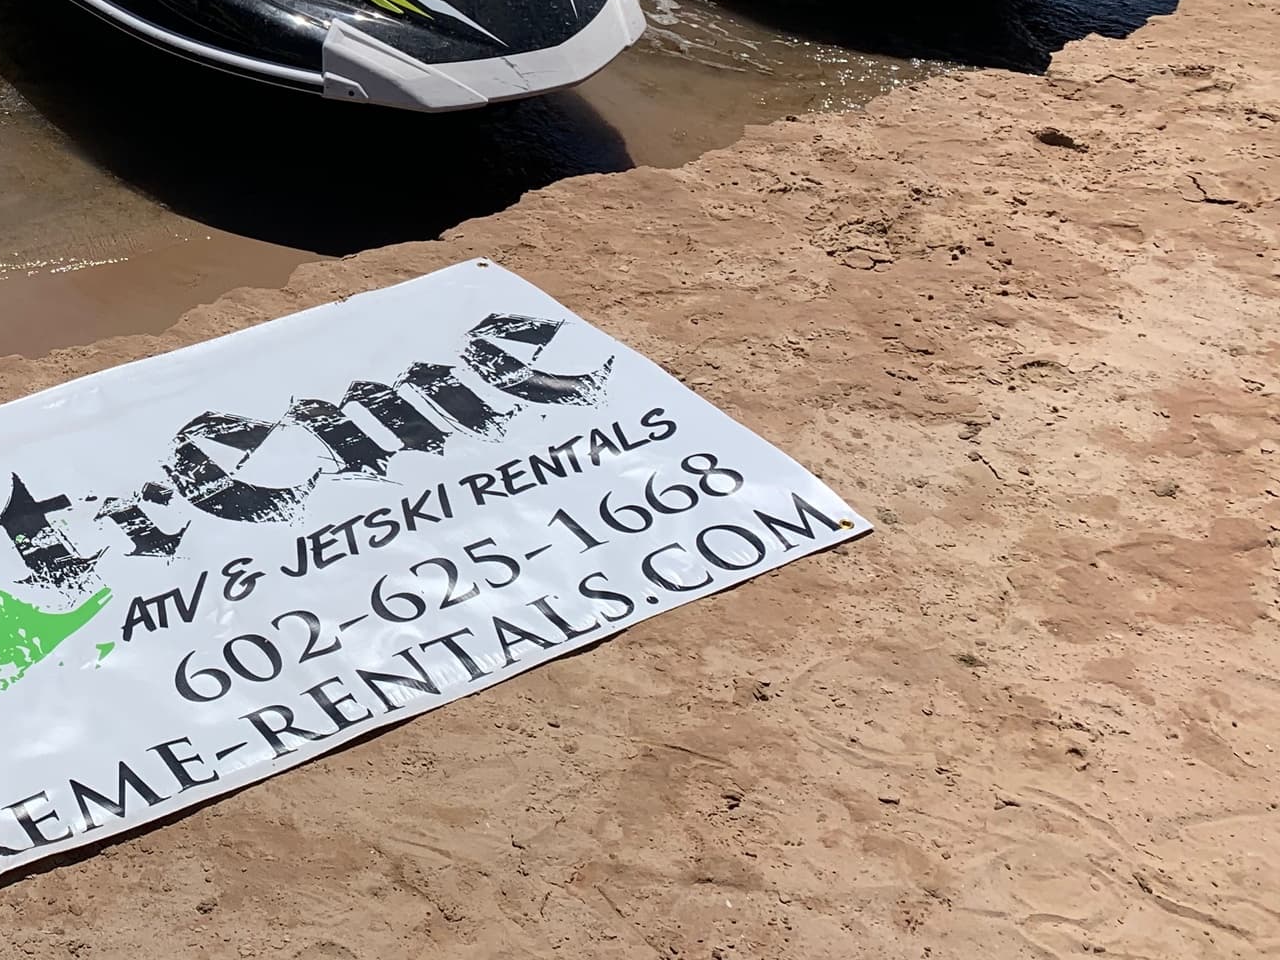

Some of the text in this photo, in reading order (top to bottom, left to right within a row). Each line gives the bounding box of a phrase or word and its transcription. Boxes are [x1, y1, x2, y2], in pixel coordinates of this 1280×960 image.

[121, 406, 678, 642] ATV & JETSKI RENTALS
[174, 451, 745, 703] 602-625-1668
